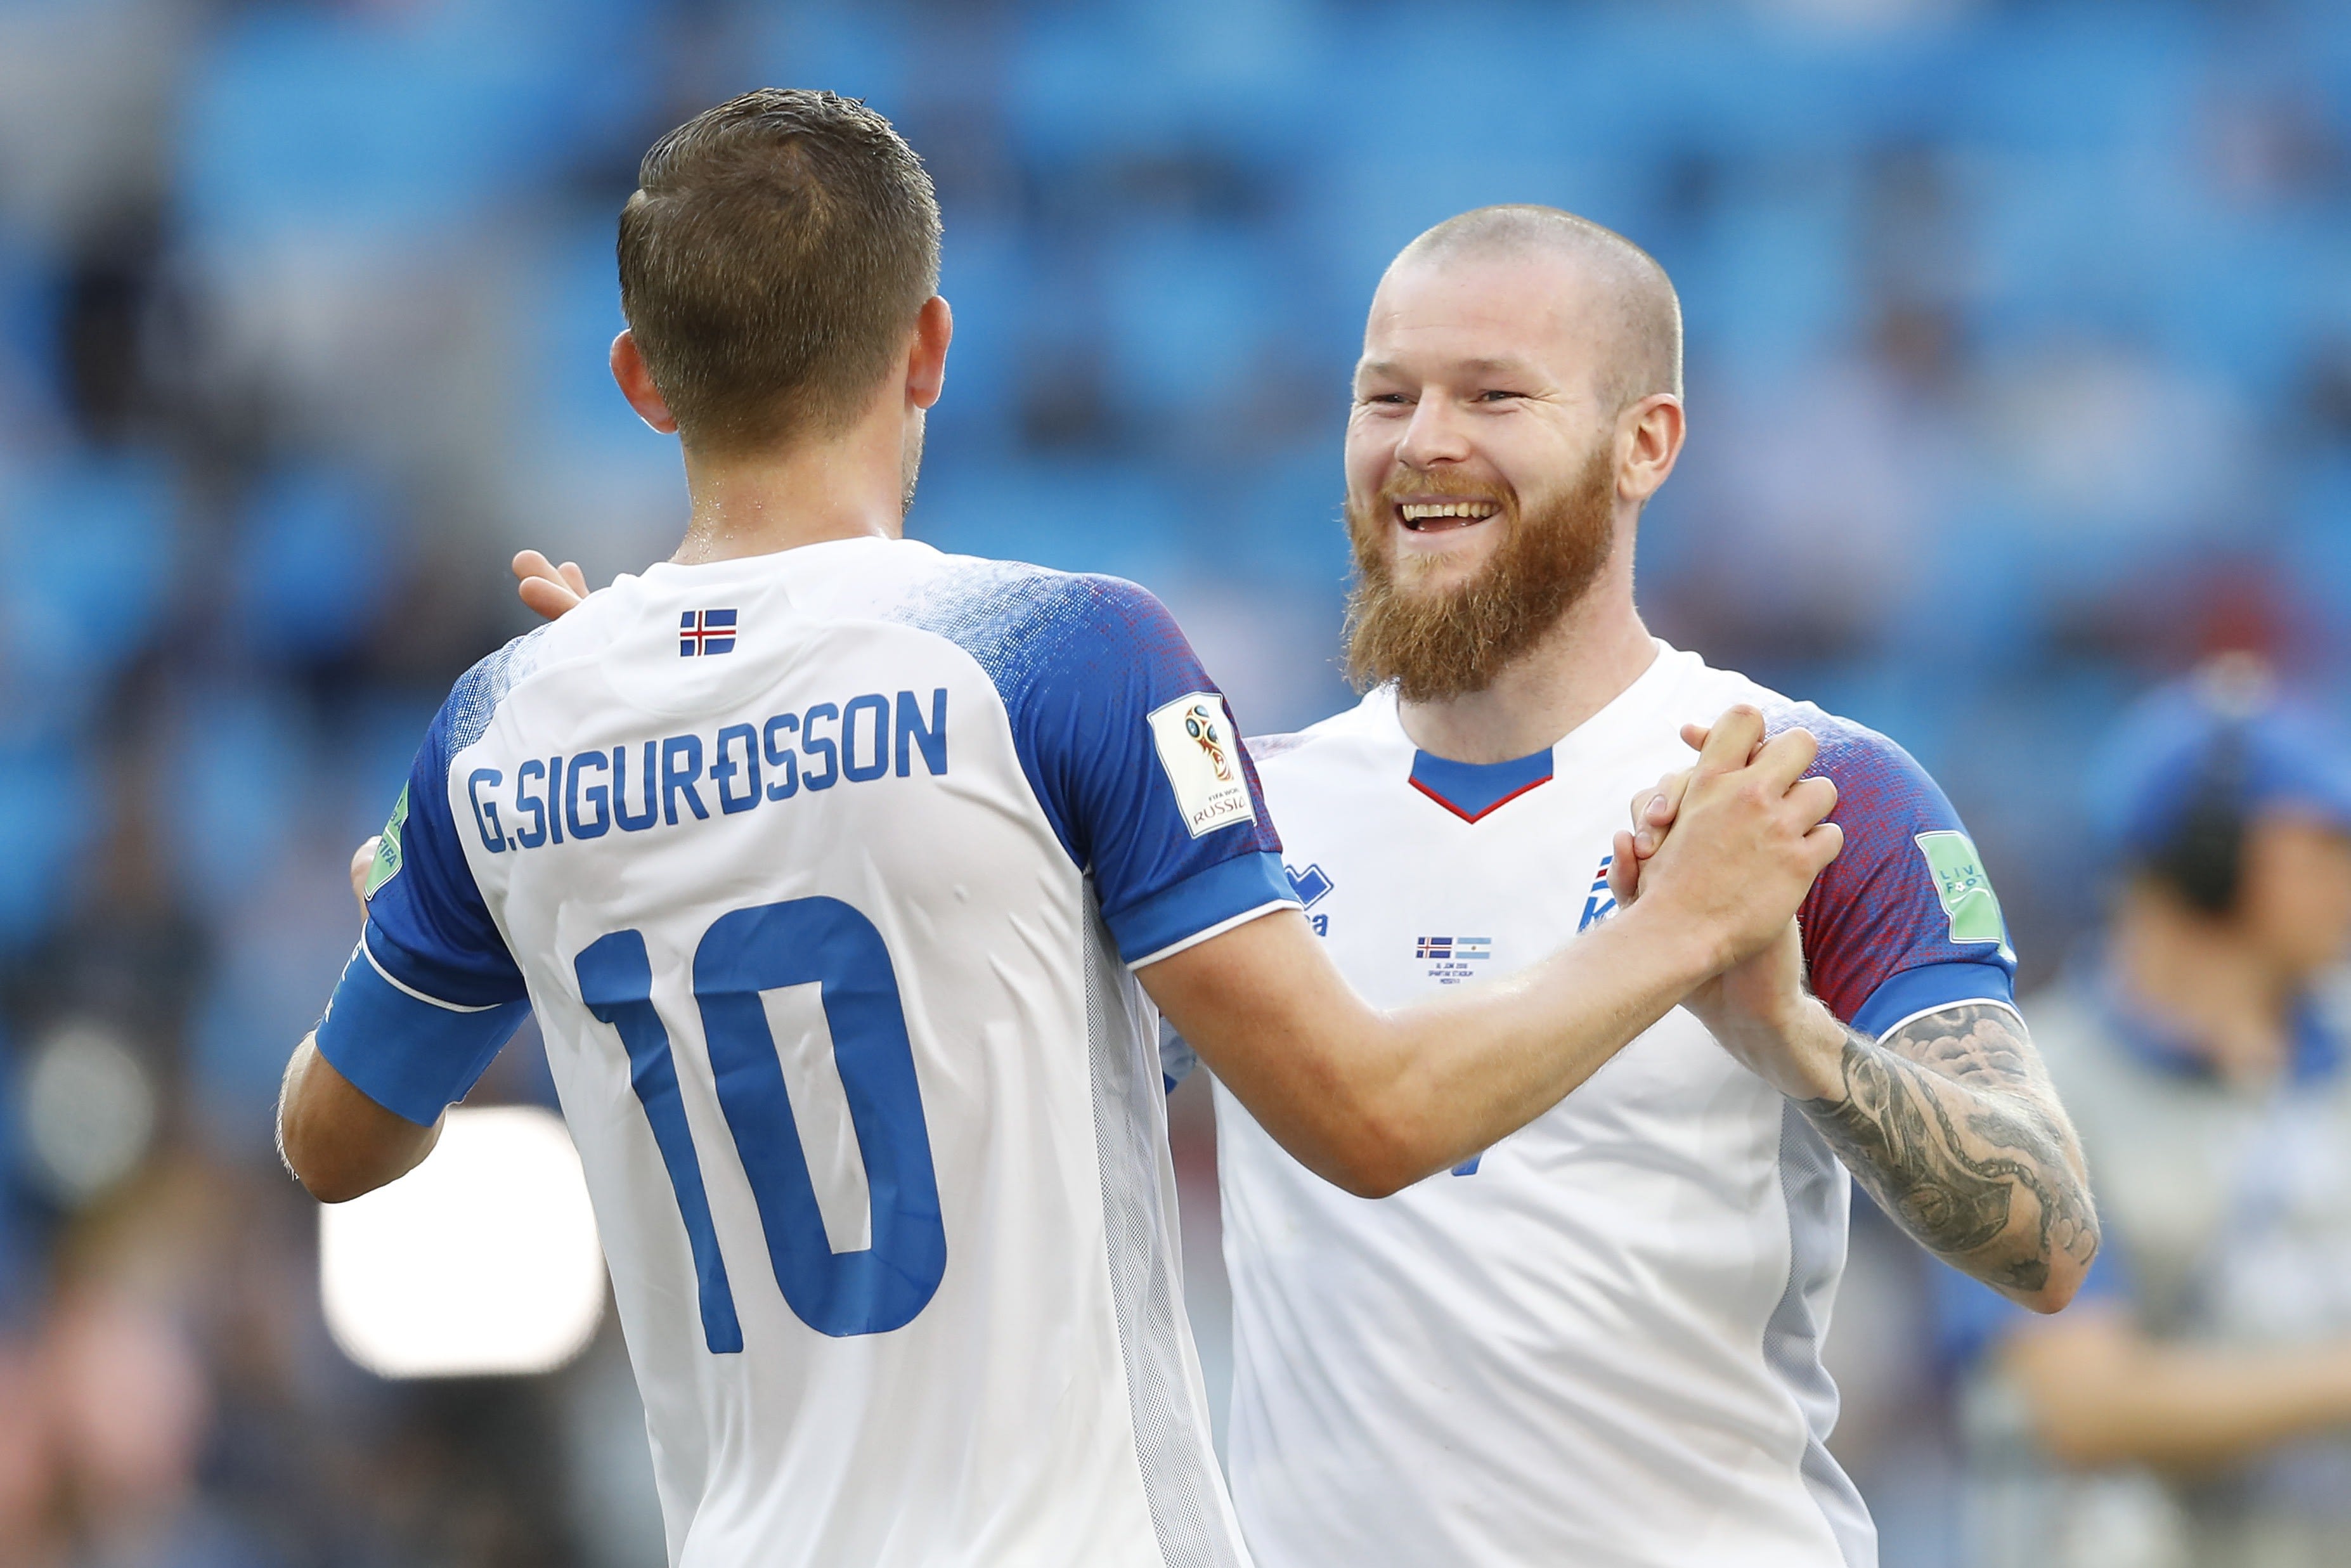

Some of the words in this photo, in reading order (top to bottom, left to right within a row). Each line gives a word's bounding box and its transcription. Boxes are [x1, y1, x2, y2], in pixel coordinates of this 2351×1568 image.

[467, 687, 948, 853] G.SIGURÐSSON
[1193, 796, 1247, 826] RUSSIA
[1208, 792, 1224, 802] FIFA
[1939, 864, 1974, 880] LIV
[574, 895, 947, 1354] 10
